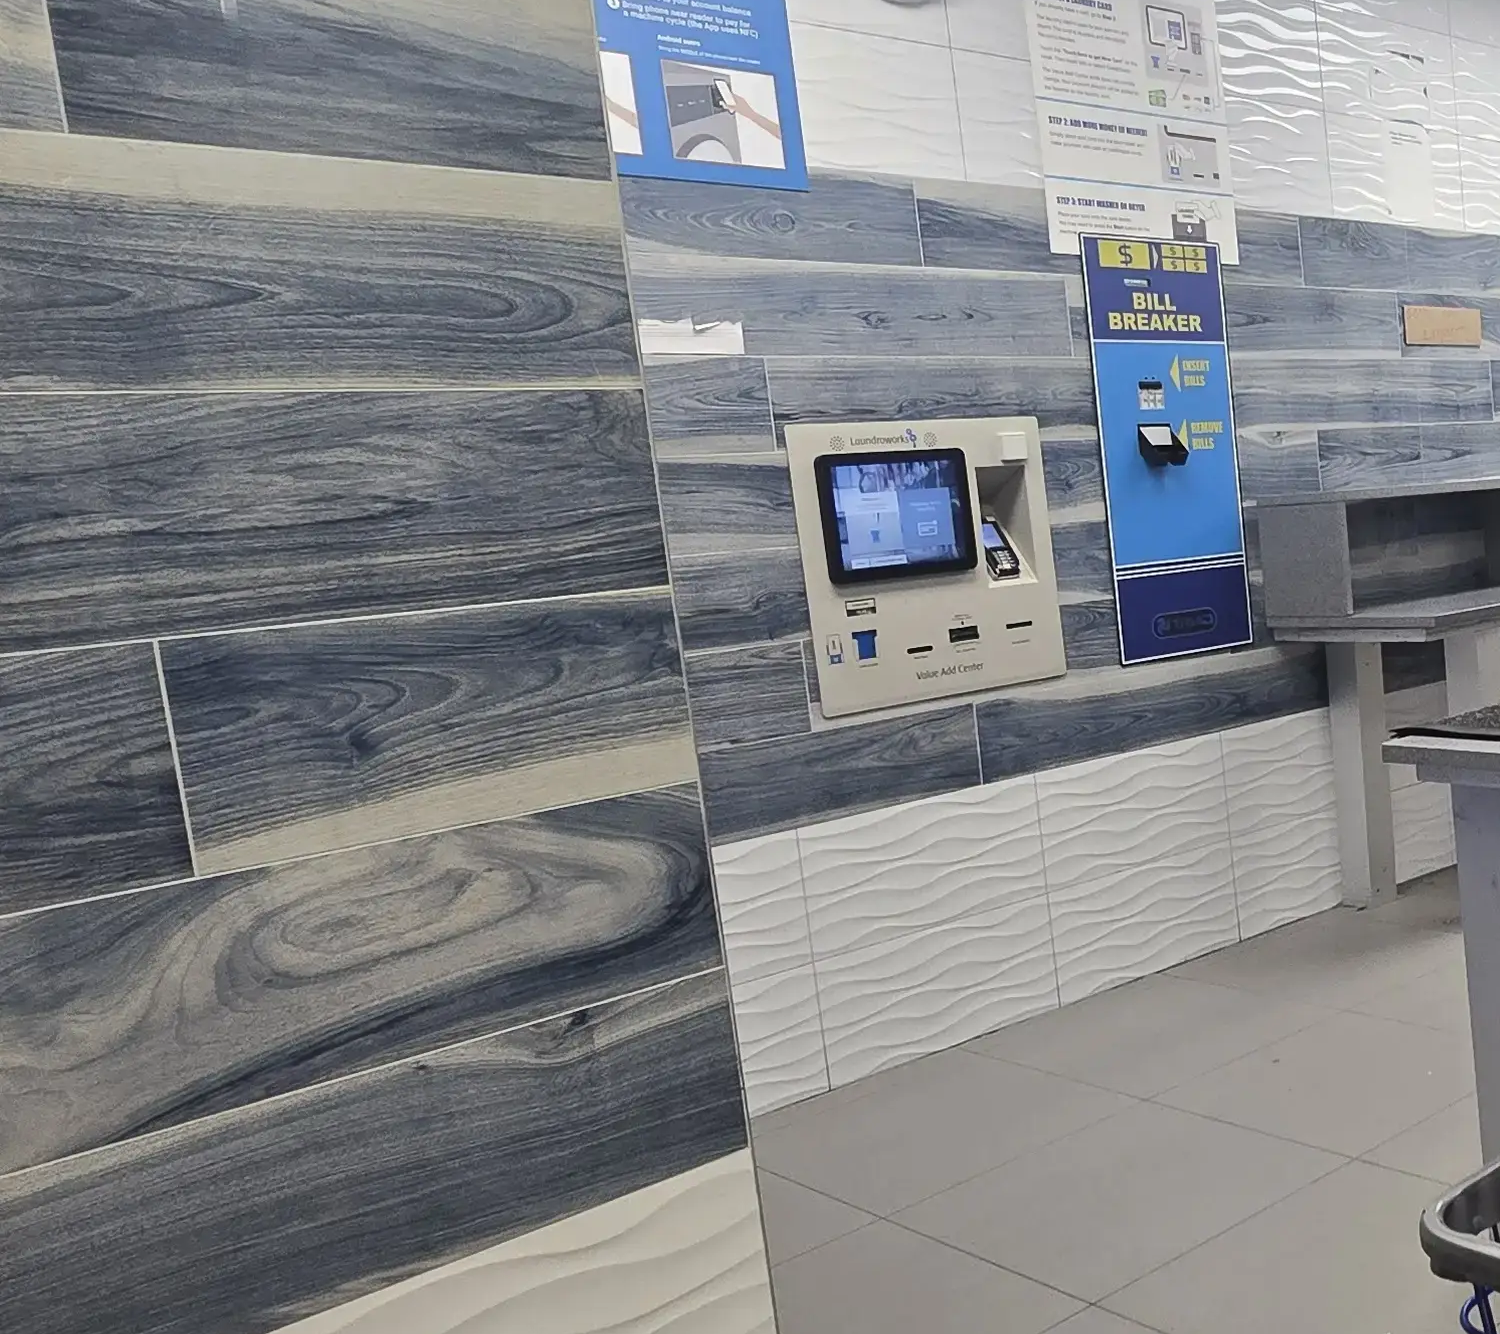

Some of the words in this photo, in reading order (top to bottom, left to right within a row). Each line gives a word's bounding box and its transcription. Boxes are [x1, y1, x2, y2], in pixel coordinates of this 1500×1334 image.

[1048, 116, 1063, 126] STEP
[1057, 196, 1071, 205] STEP
[1132, 292, 1177, 312] BILL
[1108, 312, 1203, 332] BREAKER
[849, 435, 909, 447] Laundroworks
[917, 669, 939, 680] Value
[940, 665, 958, 676] Add
[958, 662, 985, 674] Center
